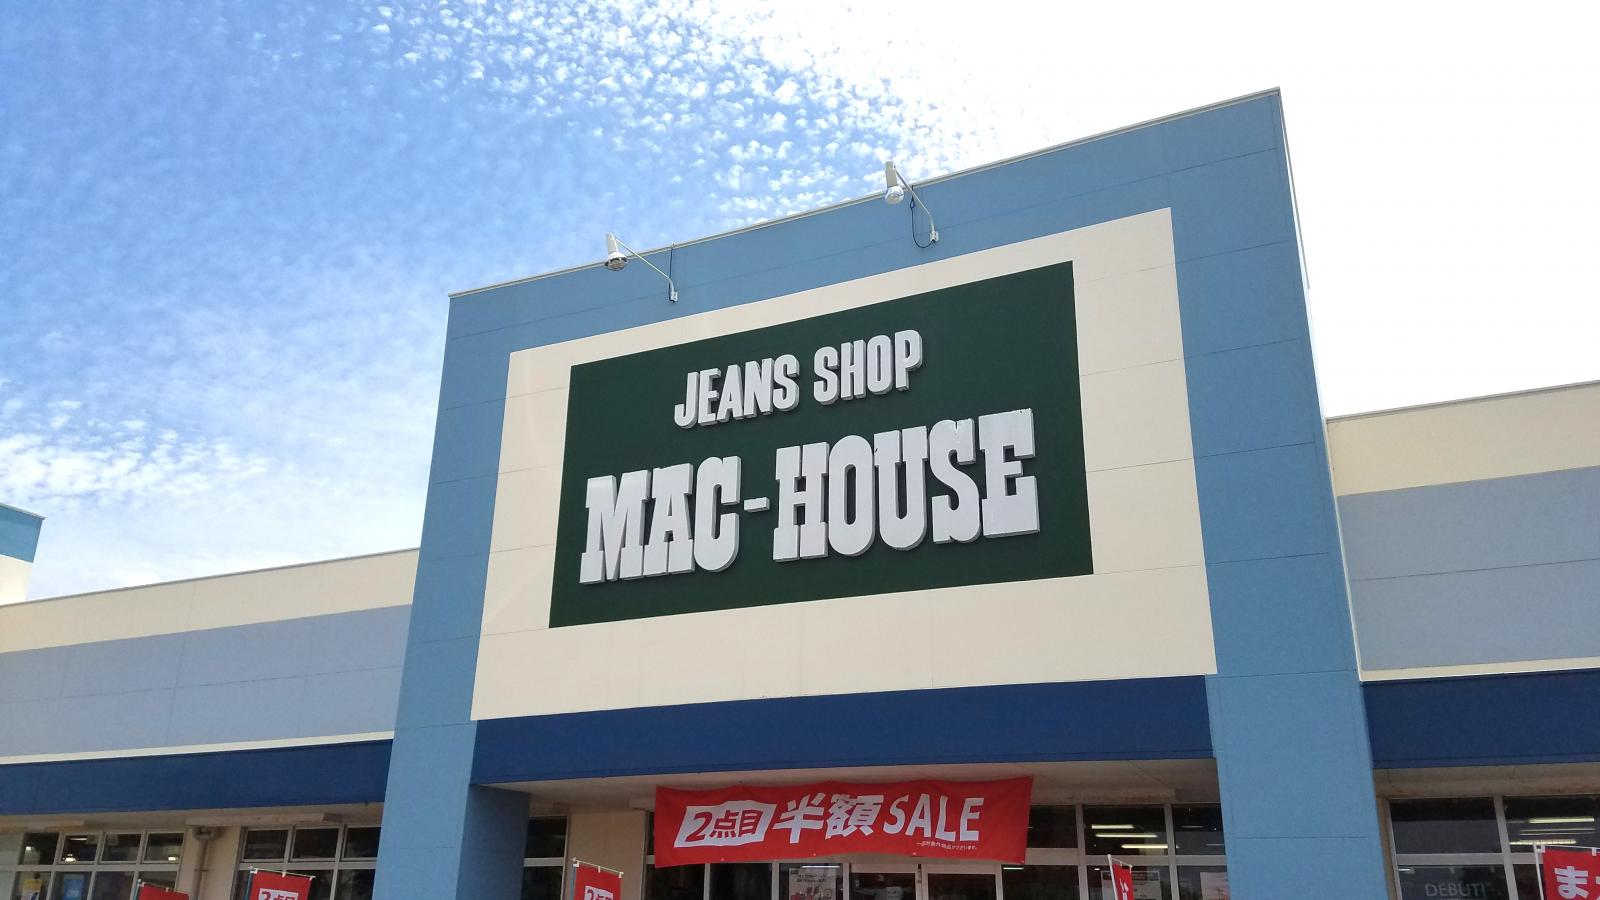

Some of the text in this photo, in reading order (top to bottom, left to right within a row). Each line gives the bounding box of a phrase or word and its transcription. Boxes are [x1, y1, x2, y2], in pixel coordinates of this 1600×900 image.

[673, 329, 923, 430] JEANS SHOP
[579, 407, 1041, 585] MAC-HOUSE
[685, 792, 985, 844] 2点目 半額 SALE
